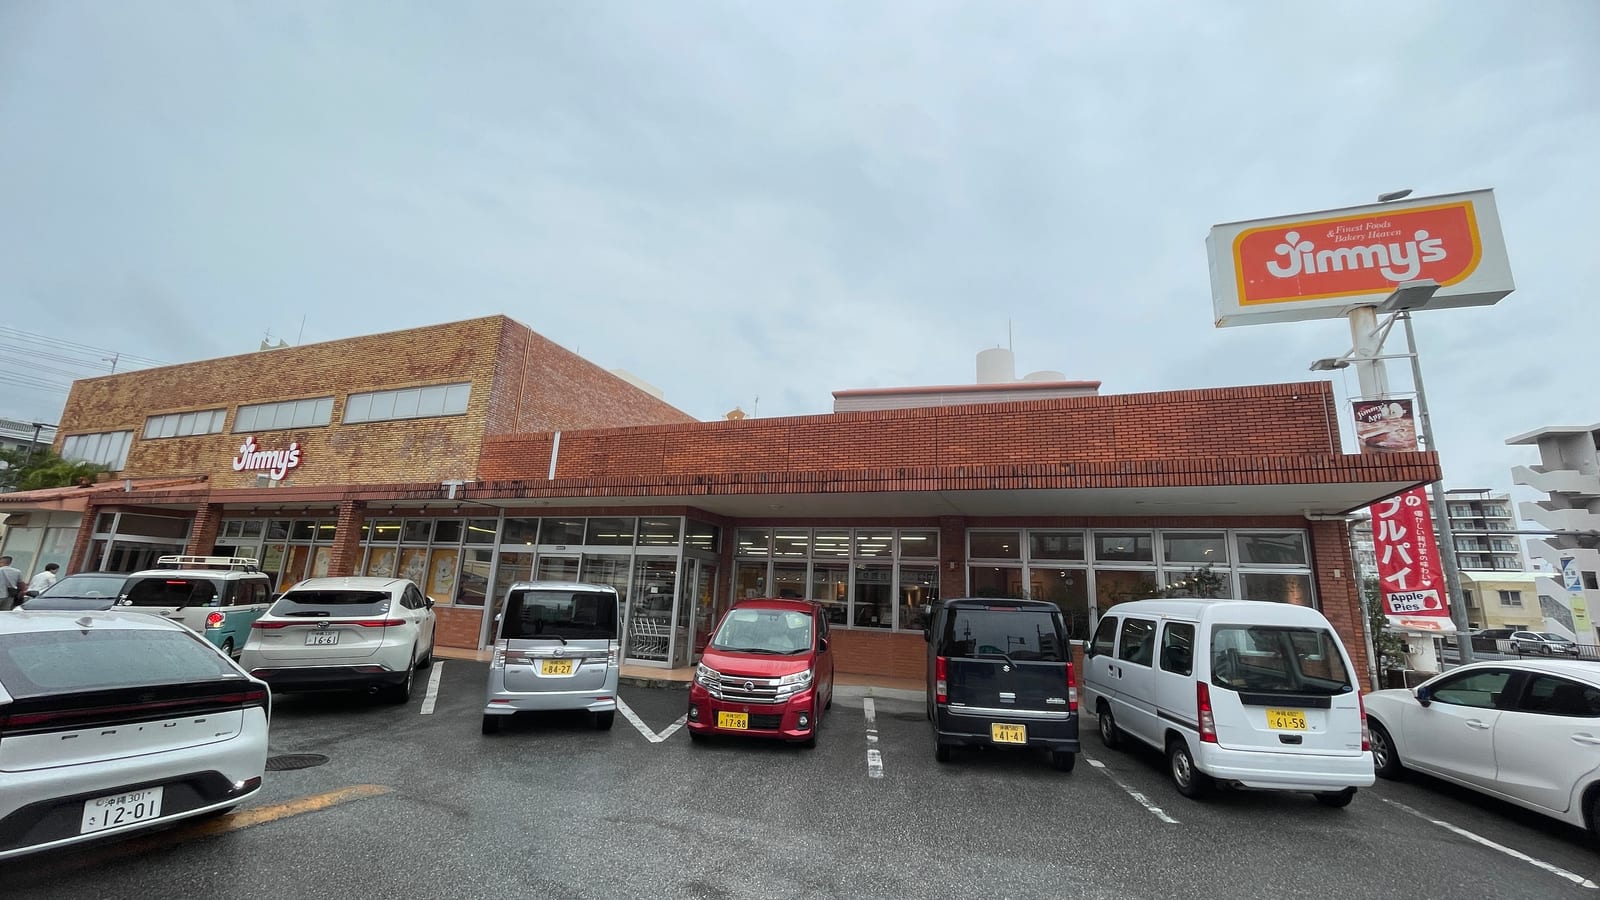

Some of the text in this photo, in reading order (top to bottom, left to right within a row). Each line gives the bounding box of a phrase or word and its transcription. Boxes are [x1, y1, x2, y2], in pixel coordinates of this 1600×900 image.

[1335, 221, 1392, 234] Finest Foods
[1326, 229, 1402, 243] & Bakery Heaven
[1266, 230, 1447, 282] Jimmy's
[1357, 402, 1385, 420] Jimmy'
[1368, 412, 1383, 422] App
[232, 436, 301, 480] Jimmy's
[1391, 593, 1424, 603] Apple
[1393, 603, 1420, 611] Pies
[548, 665, 571, 674] 84-27
[725, 718, 746, 728] 17-88
[1276, 717, 1306, 729] 61-58
[999, 731, 1023, 742] 41-41
[103, 800, 155, 827] 12-01
